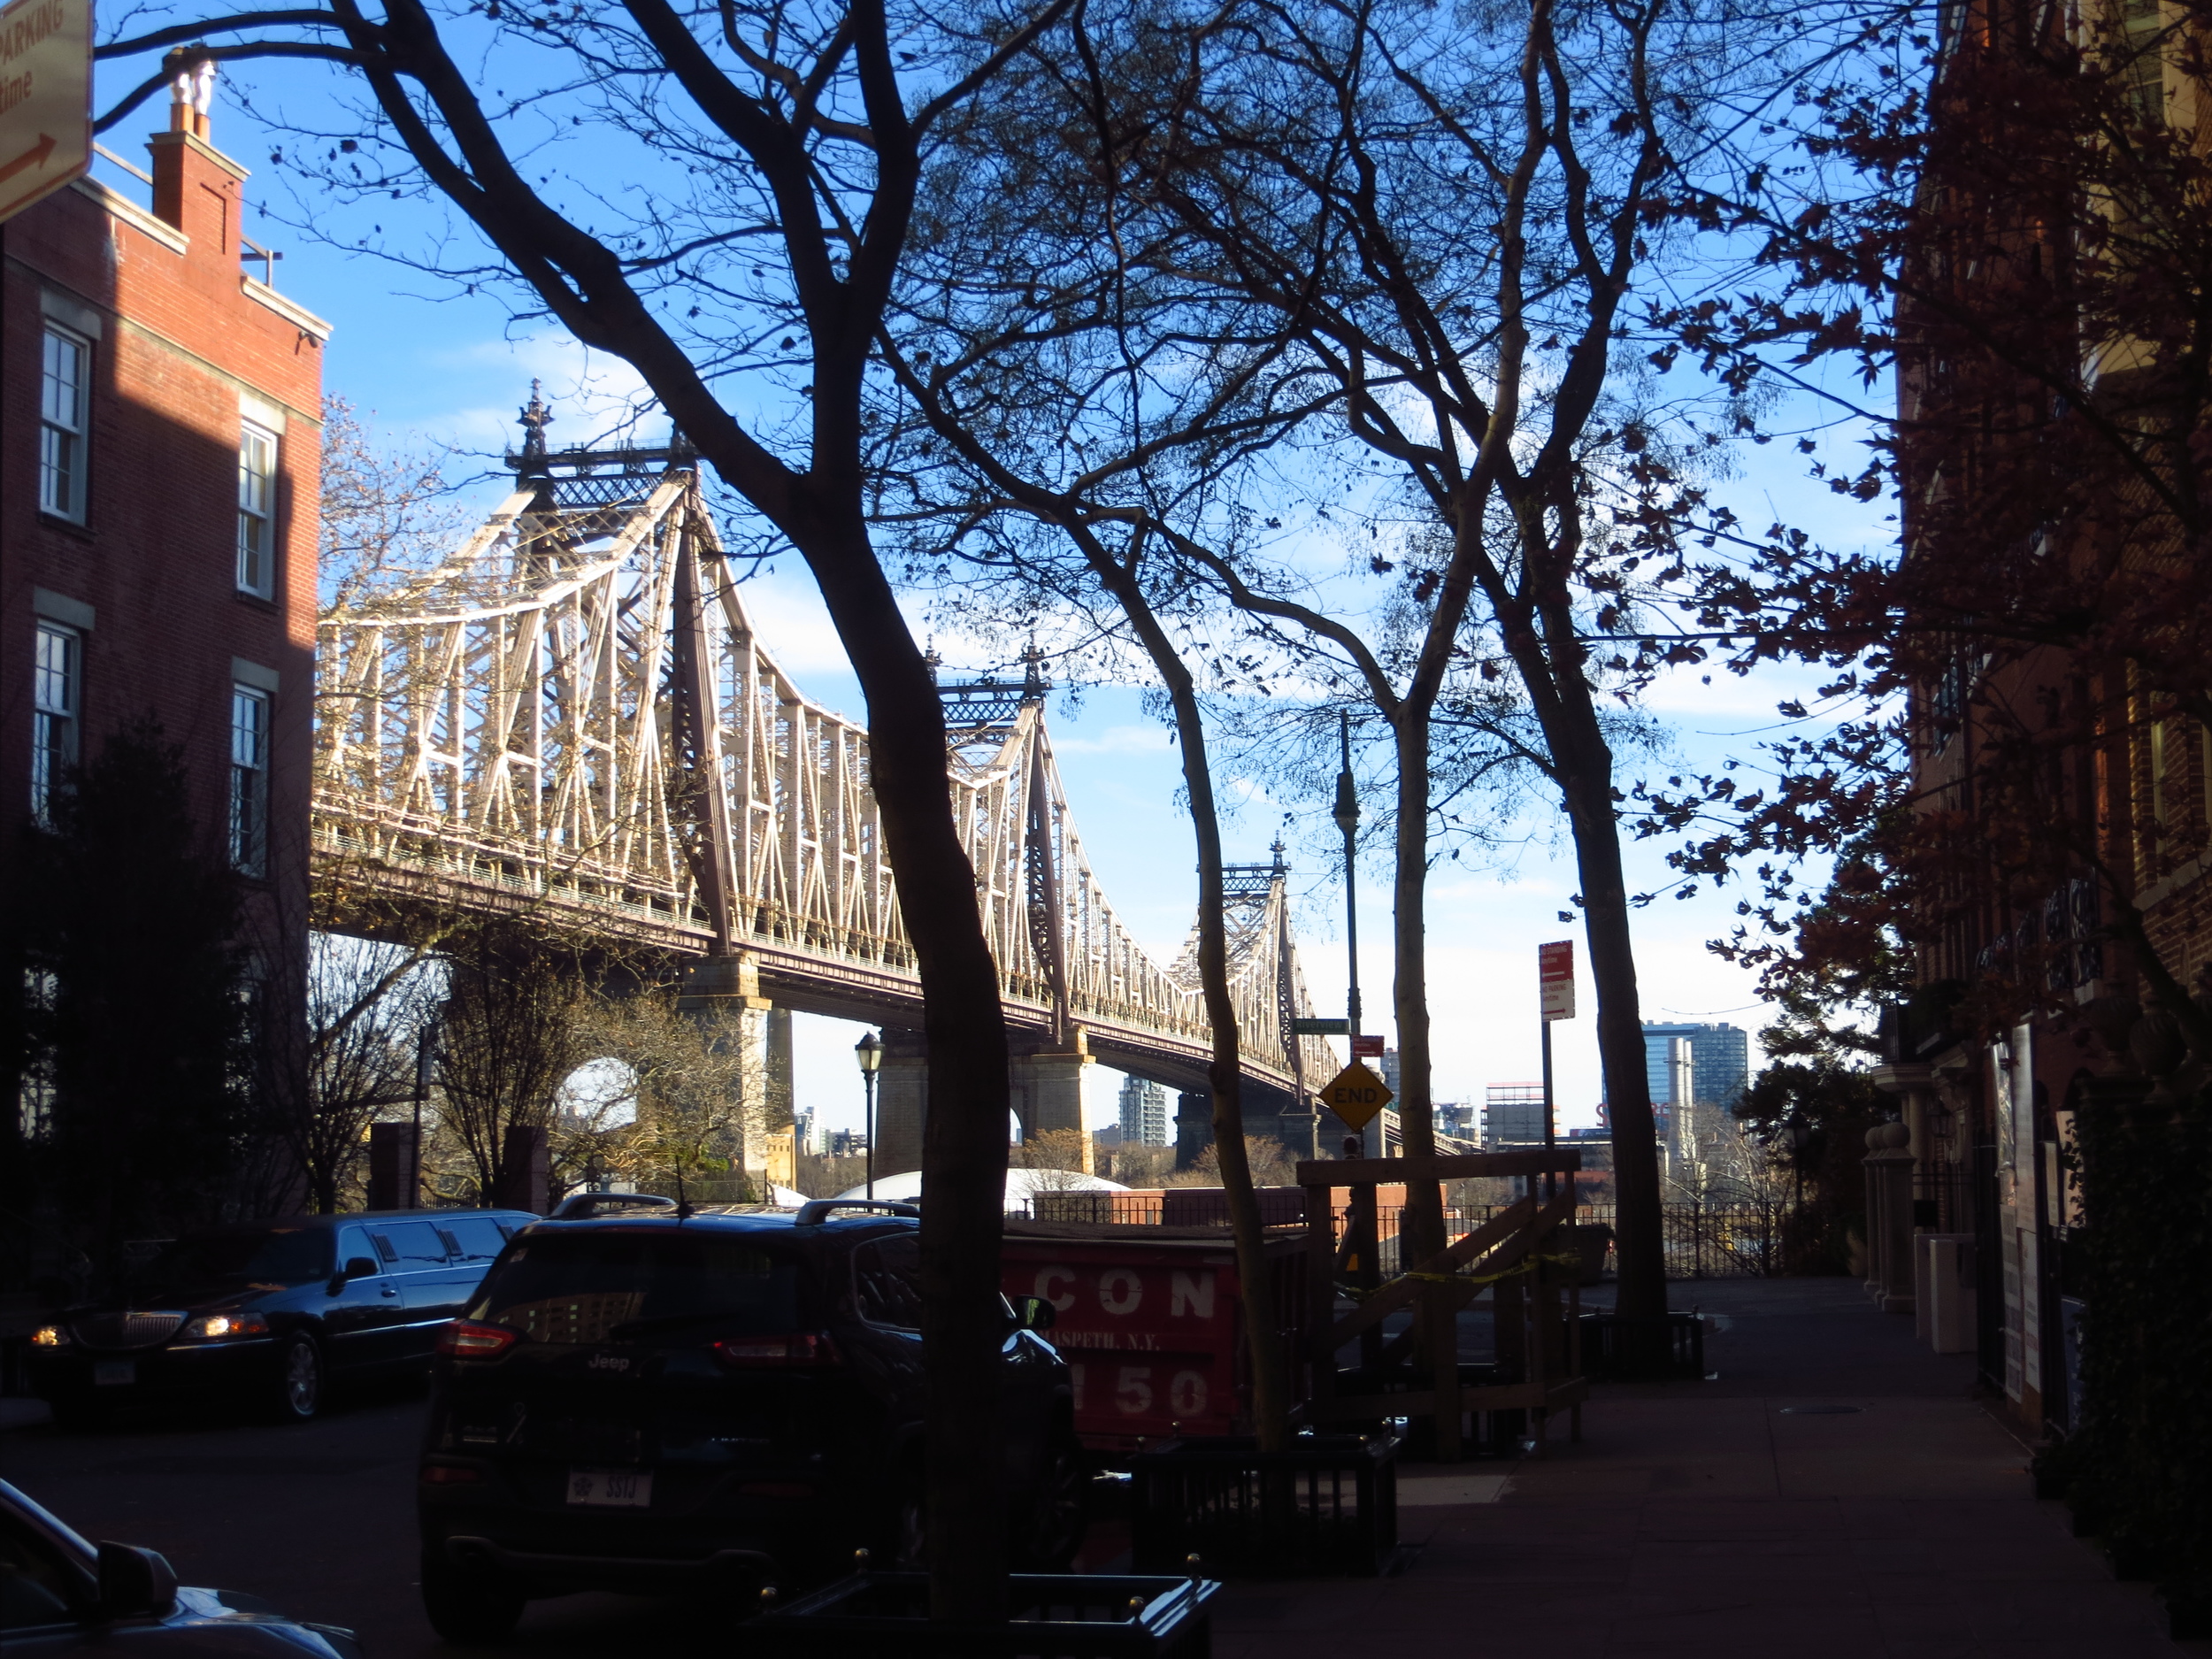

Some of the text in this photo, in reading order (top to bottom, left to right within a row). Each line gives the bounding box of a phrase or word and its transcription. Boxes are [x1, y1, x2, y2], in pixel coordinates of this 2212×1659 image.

[0, 0, 64, 65] ARKING
[1547, 945, 1568, 955] STANDING
[1548, 983, 1567, 993] PARKING
[1296, 1019, 1343, 1029] Riverview
[1334, 1087, 1378, 1104] END
[588, 1354, 630, 1372] Jeep
